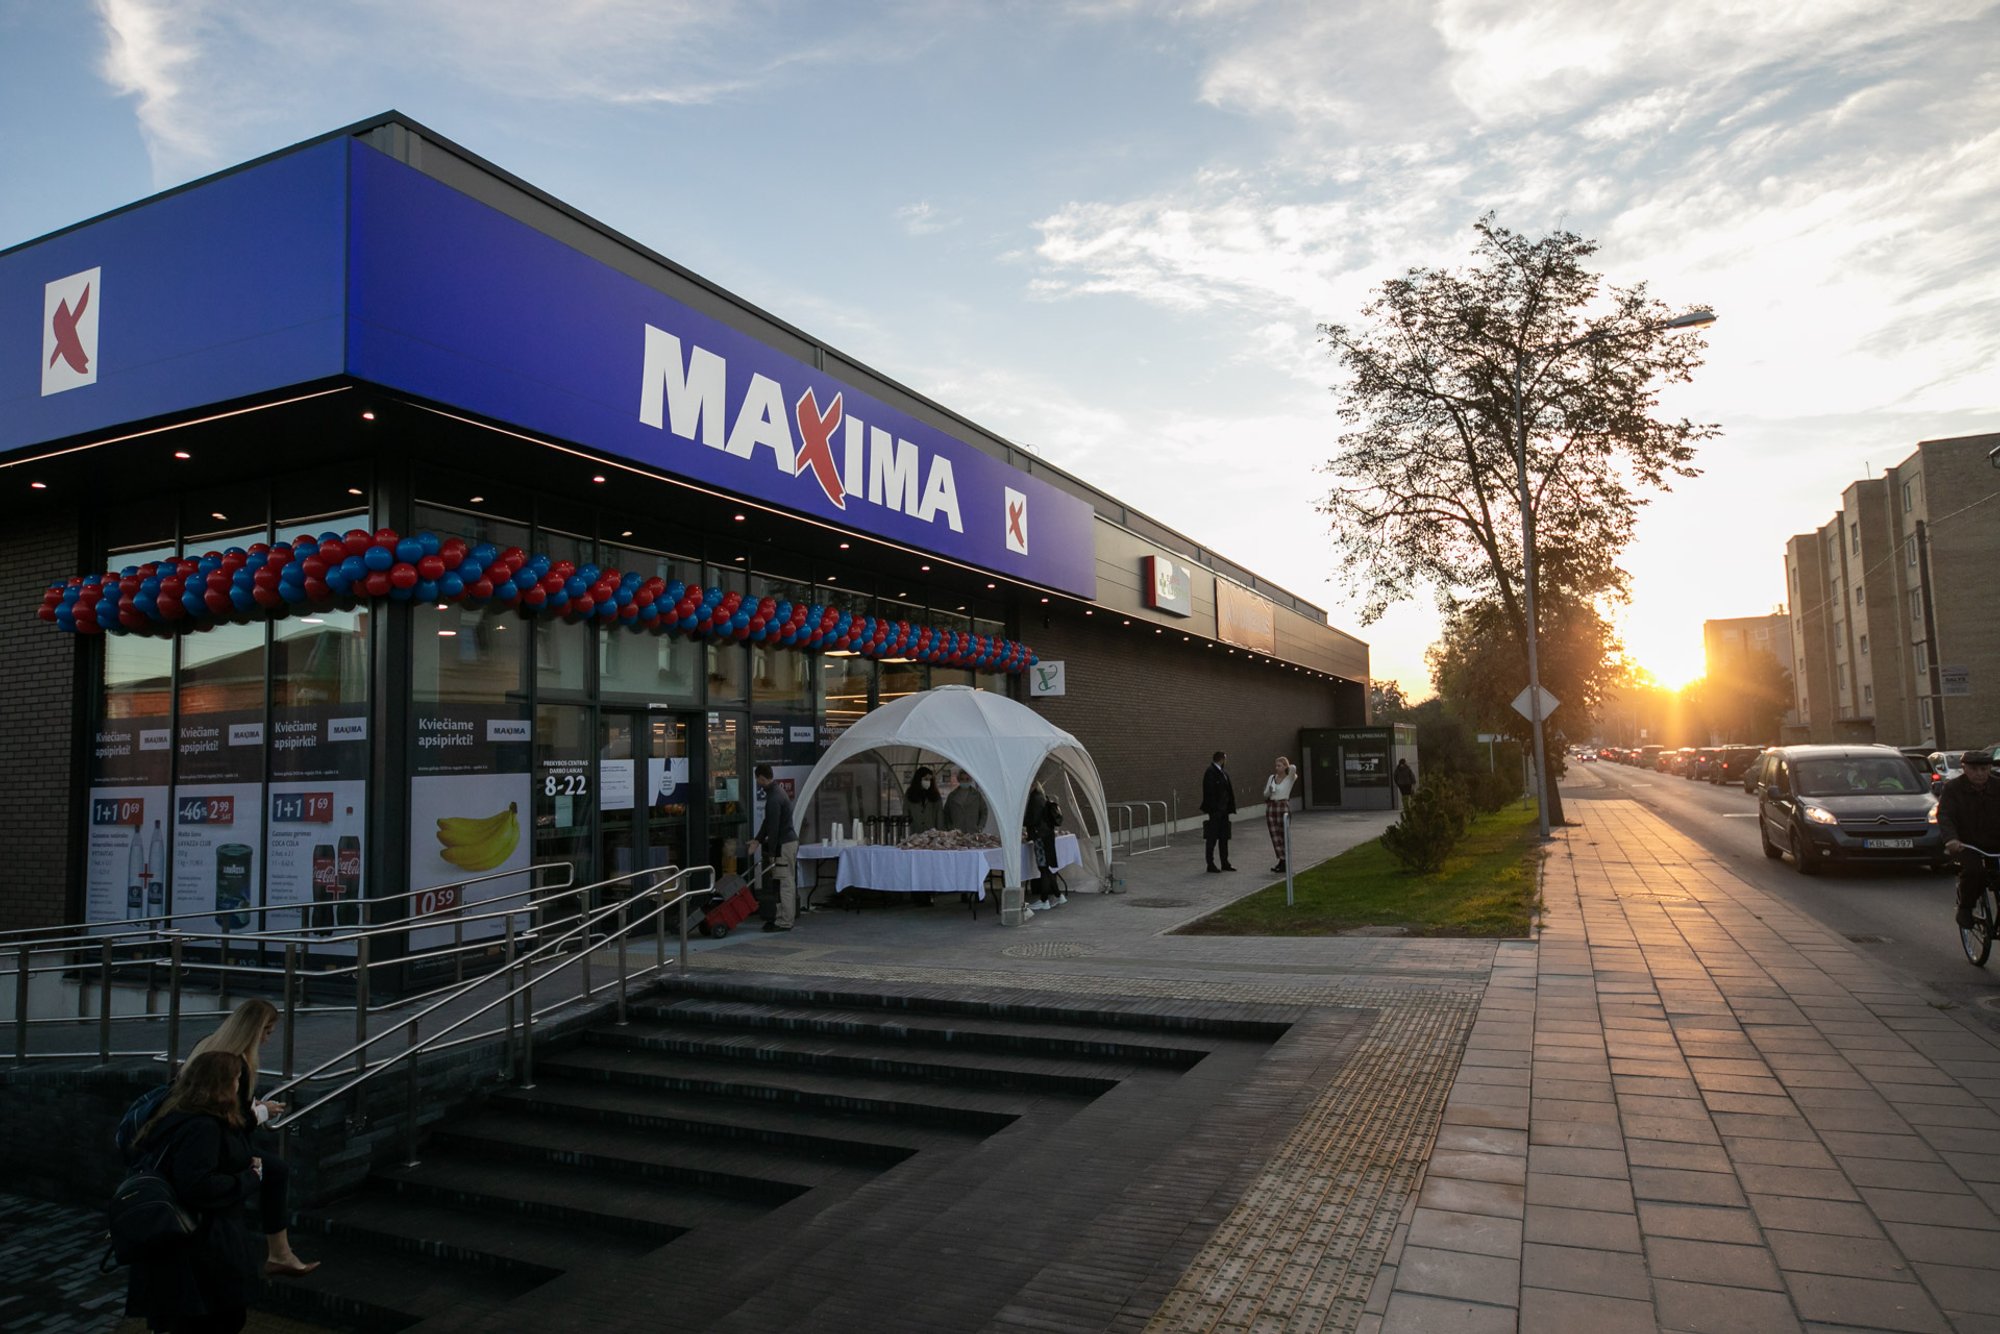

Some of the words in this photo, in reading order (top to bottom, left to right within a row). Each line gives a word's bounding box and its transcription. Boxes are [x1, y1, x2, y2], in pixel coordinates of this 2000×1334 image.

[639, 323, 964, 534] MAXIMA
[274, 721, 317, 733] Kviečiame
[333, 725, 362, 735] MAXIMA
[419, 717, 474, 730] Kviečiame
[96, 732, 131, 743] Kviečiame
[181, 727, 219, 738] Kviečiame
[233, 730, 260, 739] MAXIMA
[493, 727, 526, 735] MAXIMA
[144, 736, 167, 744] MAXIMA
[274, 736, 317, 750] apsipirkti!
[418, 734, 474, 748] apsipirkti!
[96, 745, 131, 758] apsipirkti!
[180, 741, 219, 755] apsipirkti!
[545, 775, 587, 796] 8-22
[95, 803, 119, 821] 1+1
[276, 797, 303, 818] 1+1
[1896, 839, 1911, 848] 397
